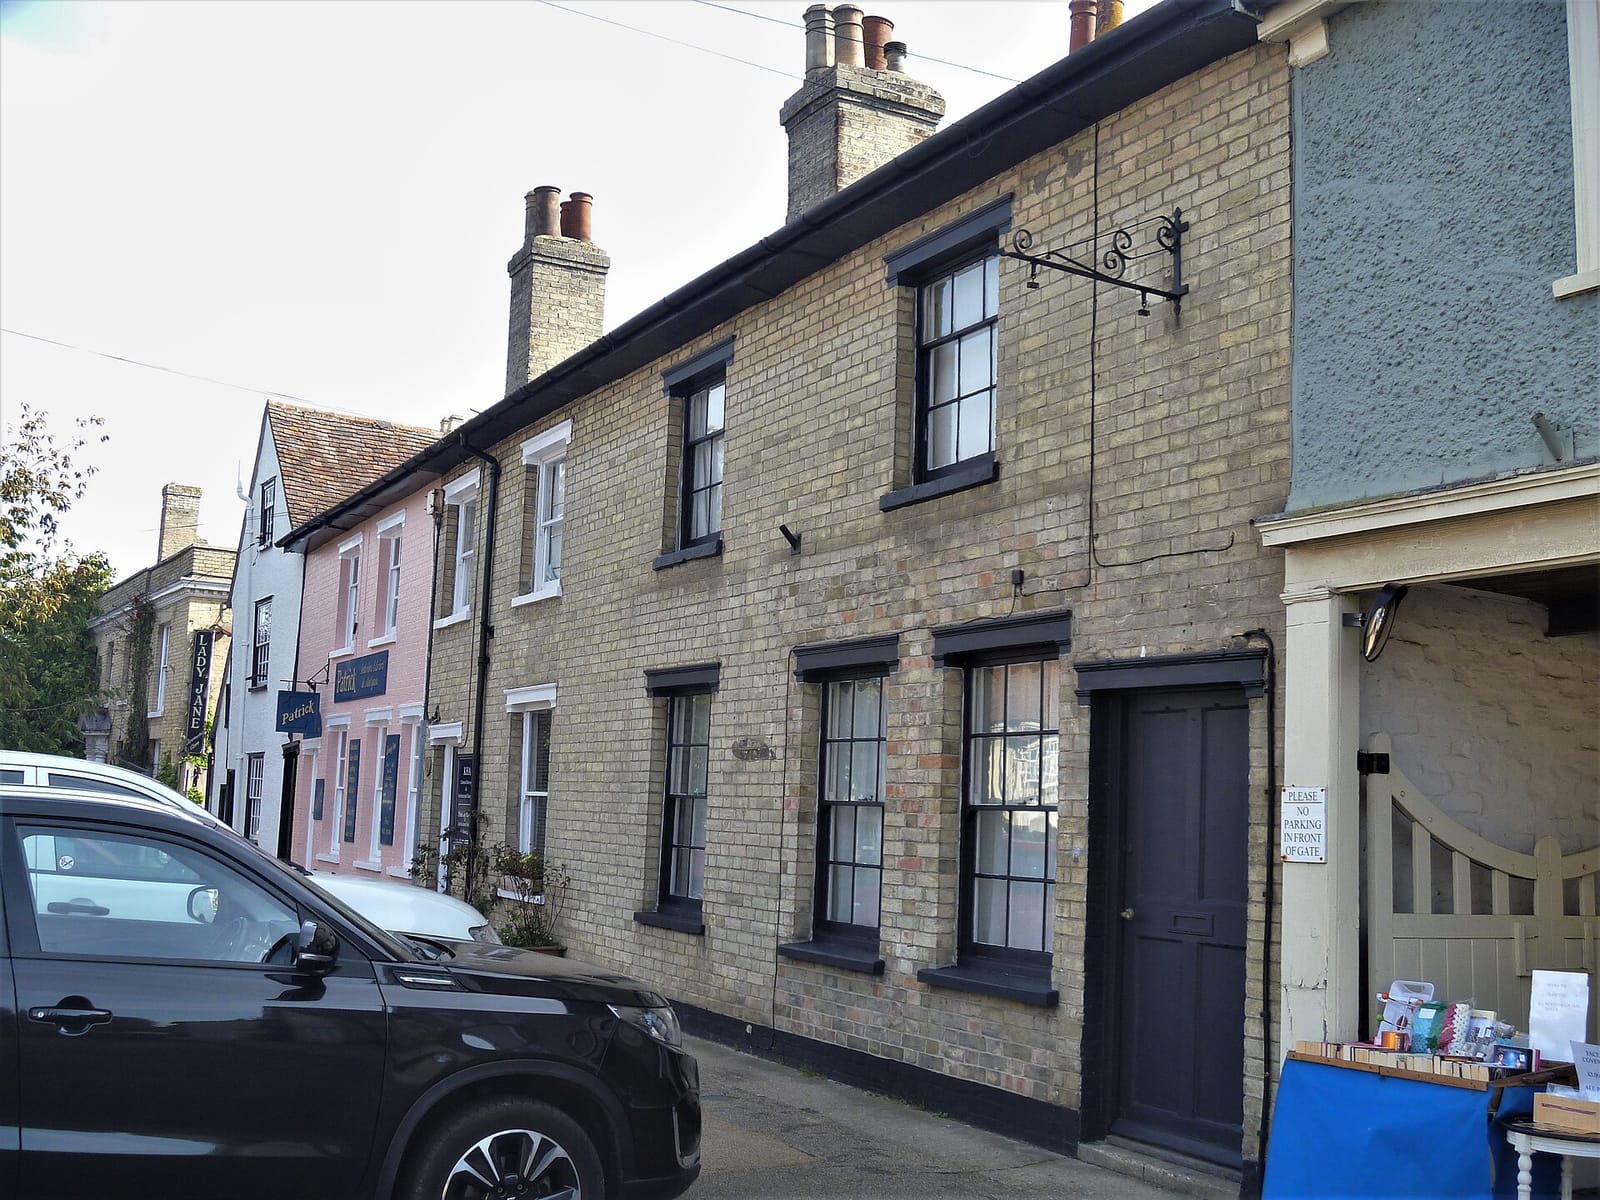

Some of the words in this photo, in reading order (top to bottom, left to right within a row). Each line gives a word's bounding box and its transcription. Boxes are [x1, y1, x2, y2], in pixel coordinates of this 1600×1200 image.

[197, 634, 208, 678] LADY
[335, 668, 357, 694] Patrick
[191, 683, 204, 729] JANE
[281, 699, 315, 726] Patrick
[1288, 791, 1318, 802] PLEASE
[1296, 806, 1310, 817] NO
[1284, 819, 1322, 830] PARKING
[1283, 832, 1293, 843] IN
[1294, 832, 1322, 844] FRONT
[1285, 845, 1297, 856] OF
[1297, 846, 1320, 857] GATE
